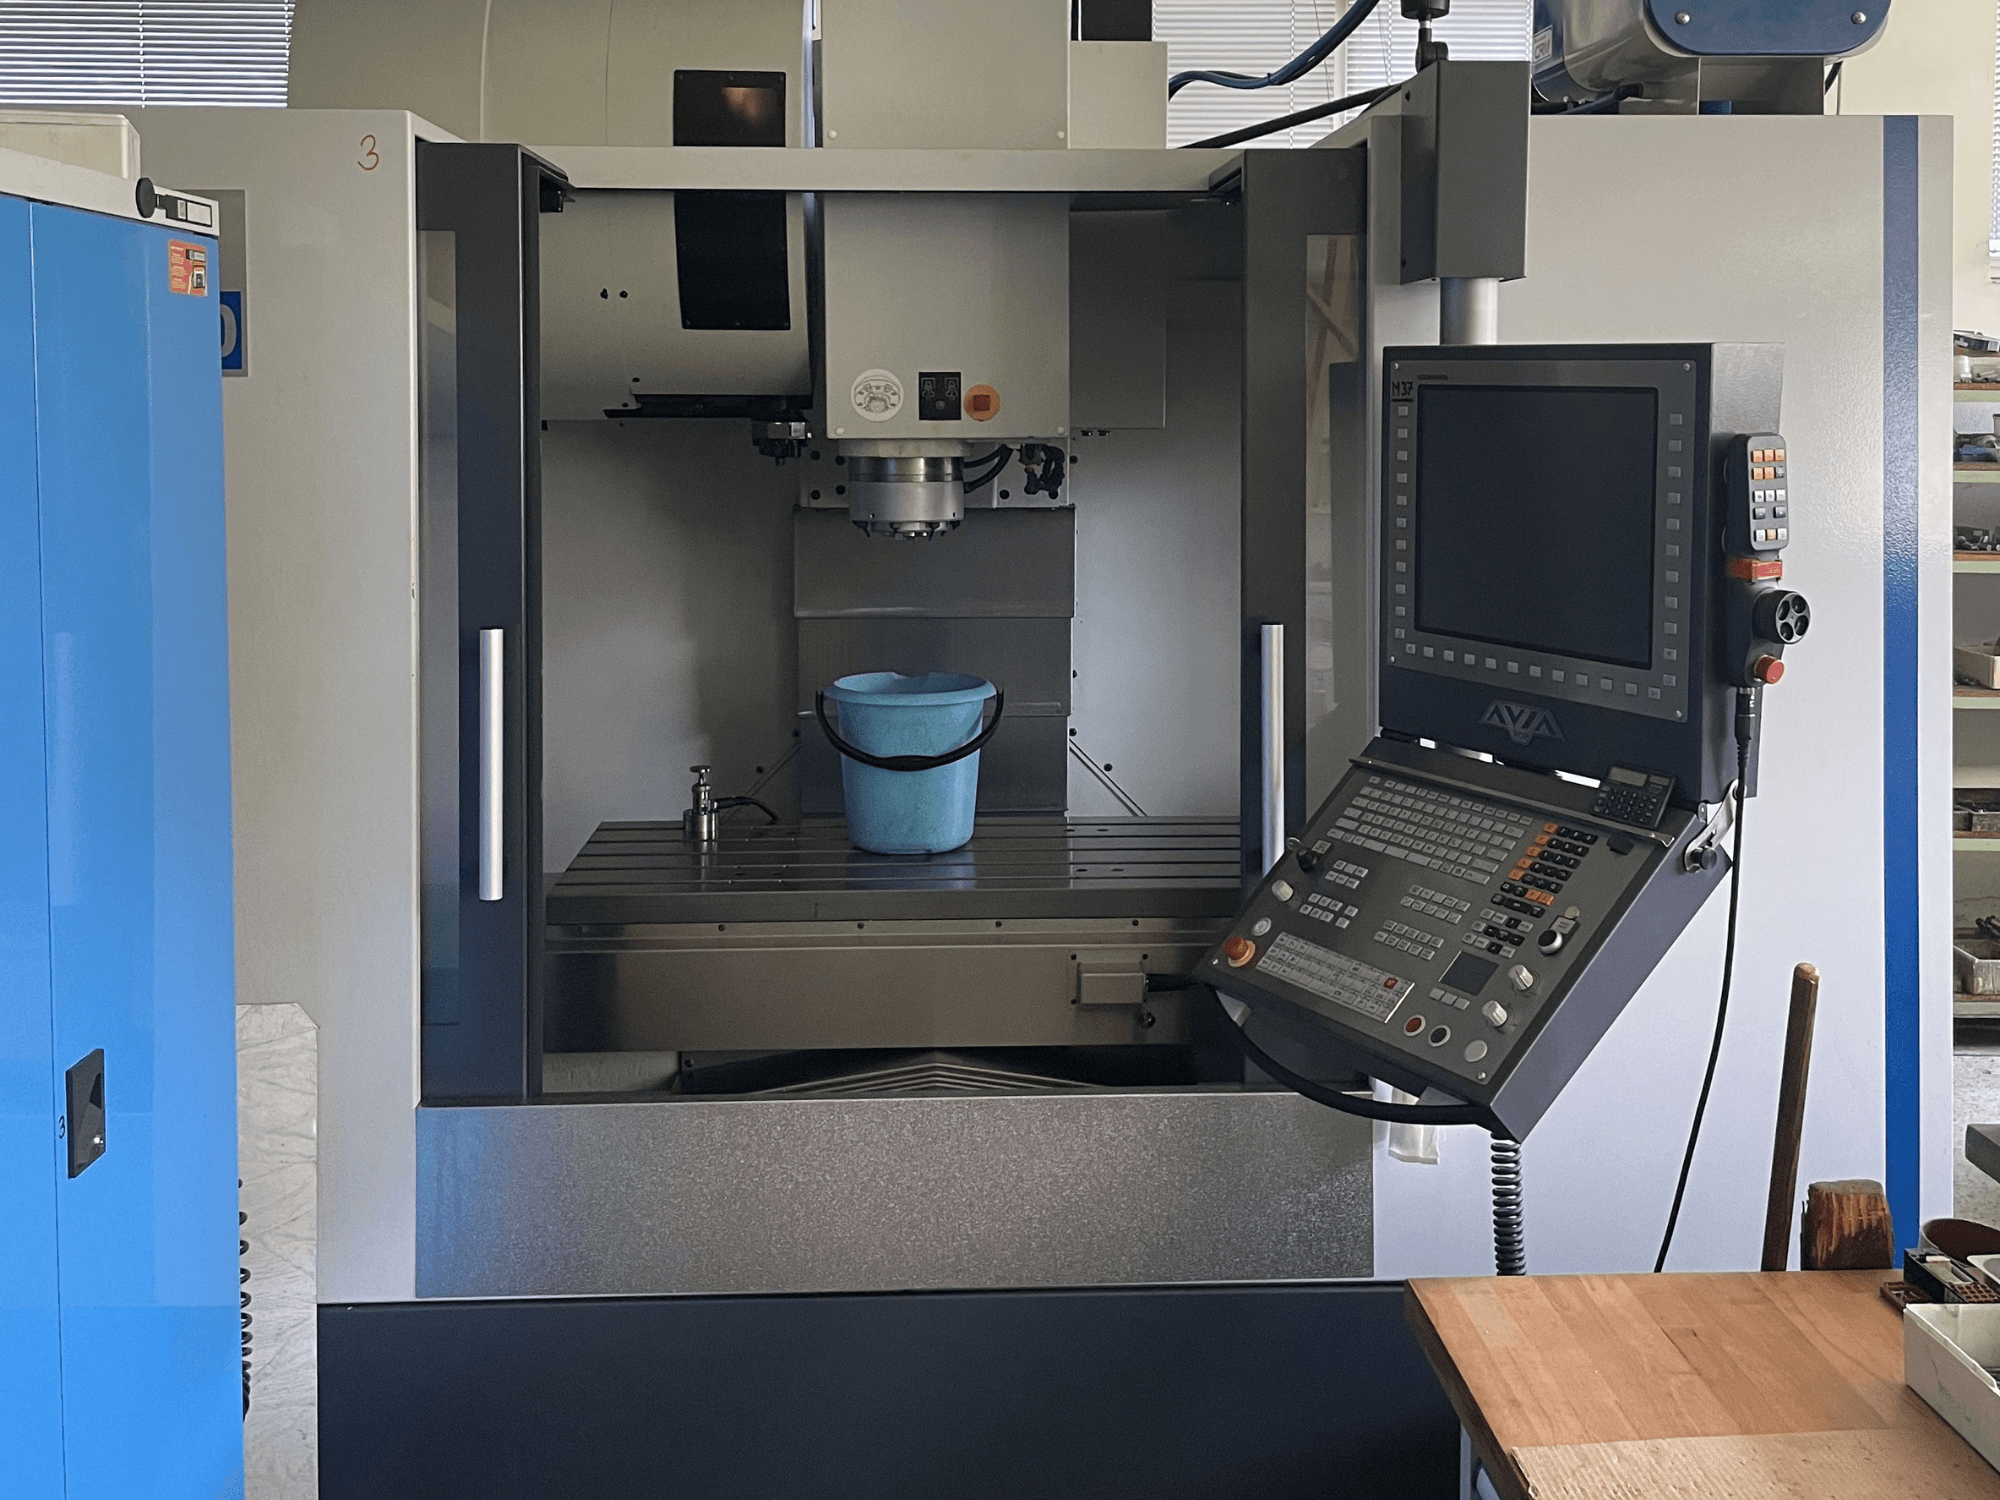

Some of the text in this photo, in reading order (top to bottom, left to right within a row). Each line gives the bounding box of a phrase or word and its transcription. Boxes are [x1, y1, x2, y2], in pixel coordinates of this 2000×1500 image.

[358, 134, 379, 170] 3
[1392, 381, 1413, 396] M37
[1484, 703, 1557, 737] AVIA
[59, 1115, 65, 1139] 3
